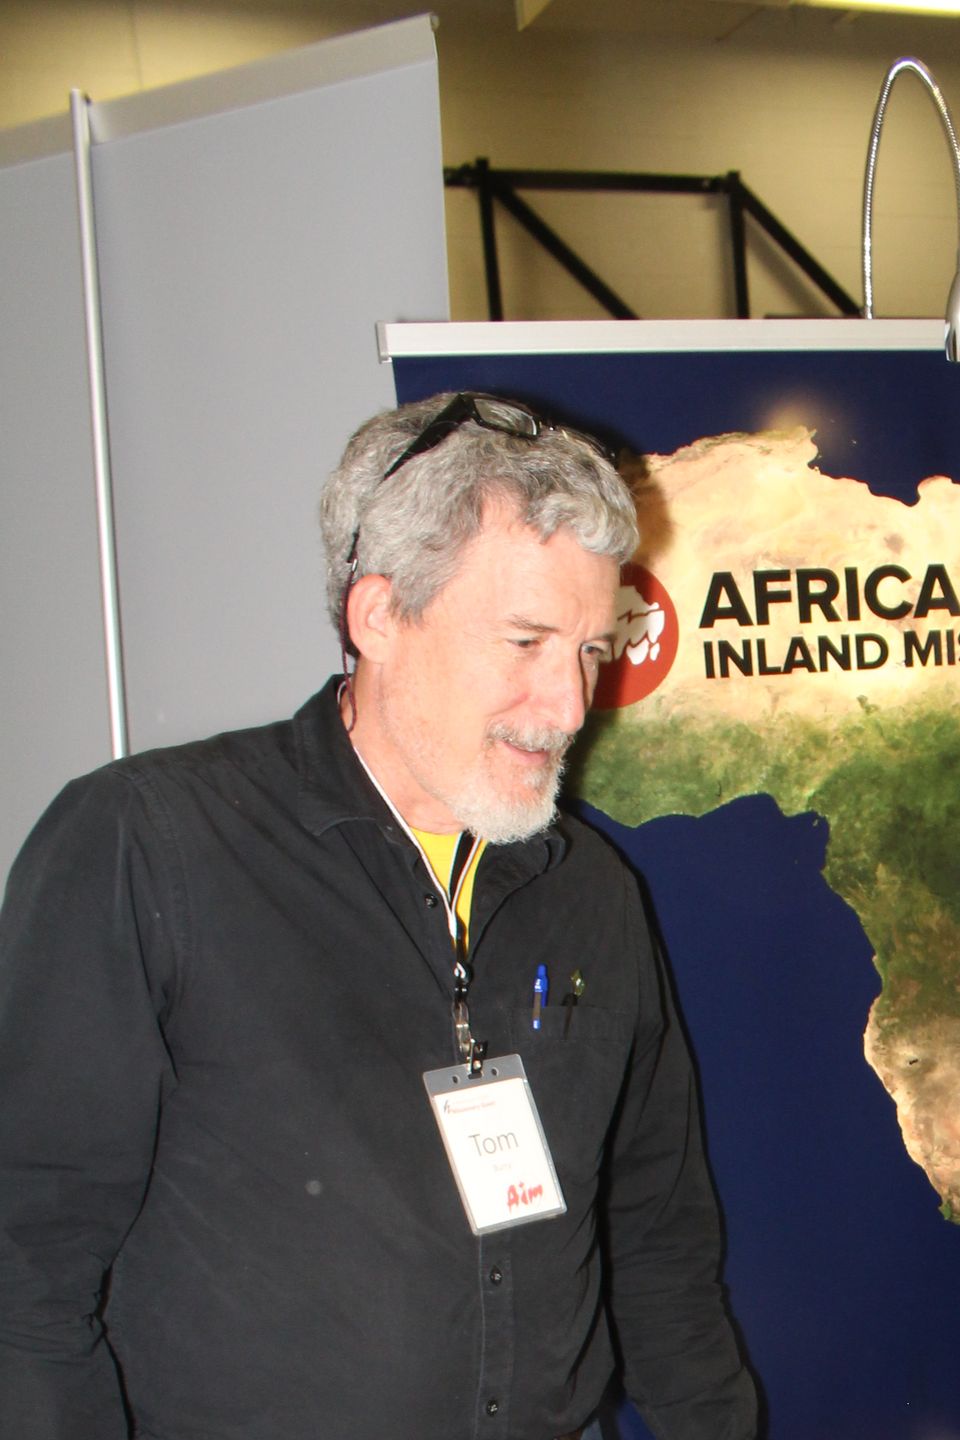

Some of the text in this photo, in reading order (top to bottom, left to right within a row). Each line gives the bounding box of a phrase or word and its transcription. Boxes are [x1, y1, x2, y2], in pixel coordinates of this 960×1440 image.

[703, 631, 889, 680] INLAND
[468, 1131, 519, 1157] Tom
[507, 1182, 543, 1212] Aim
